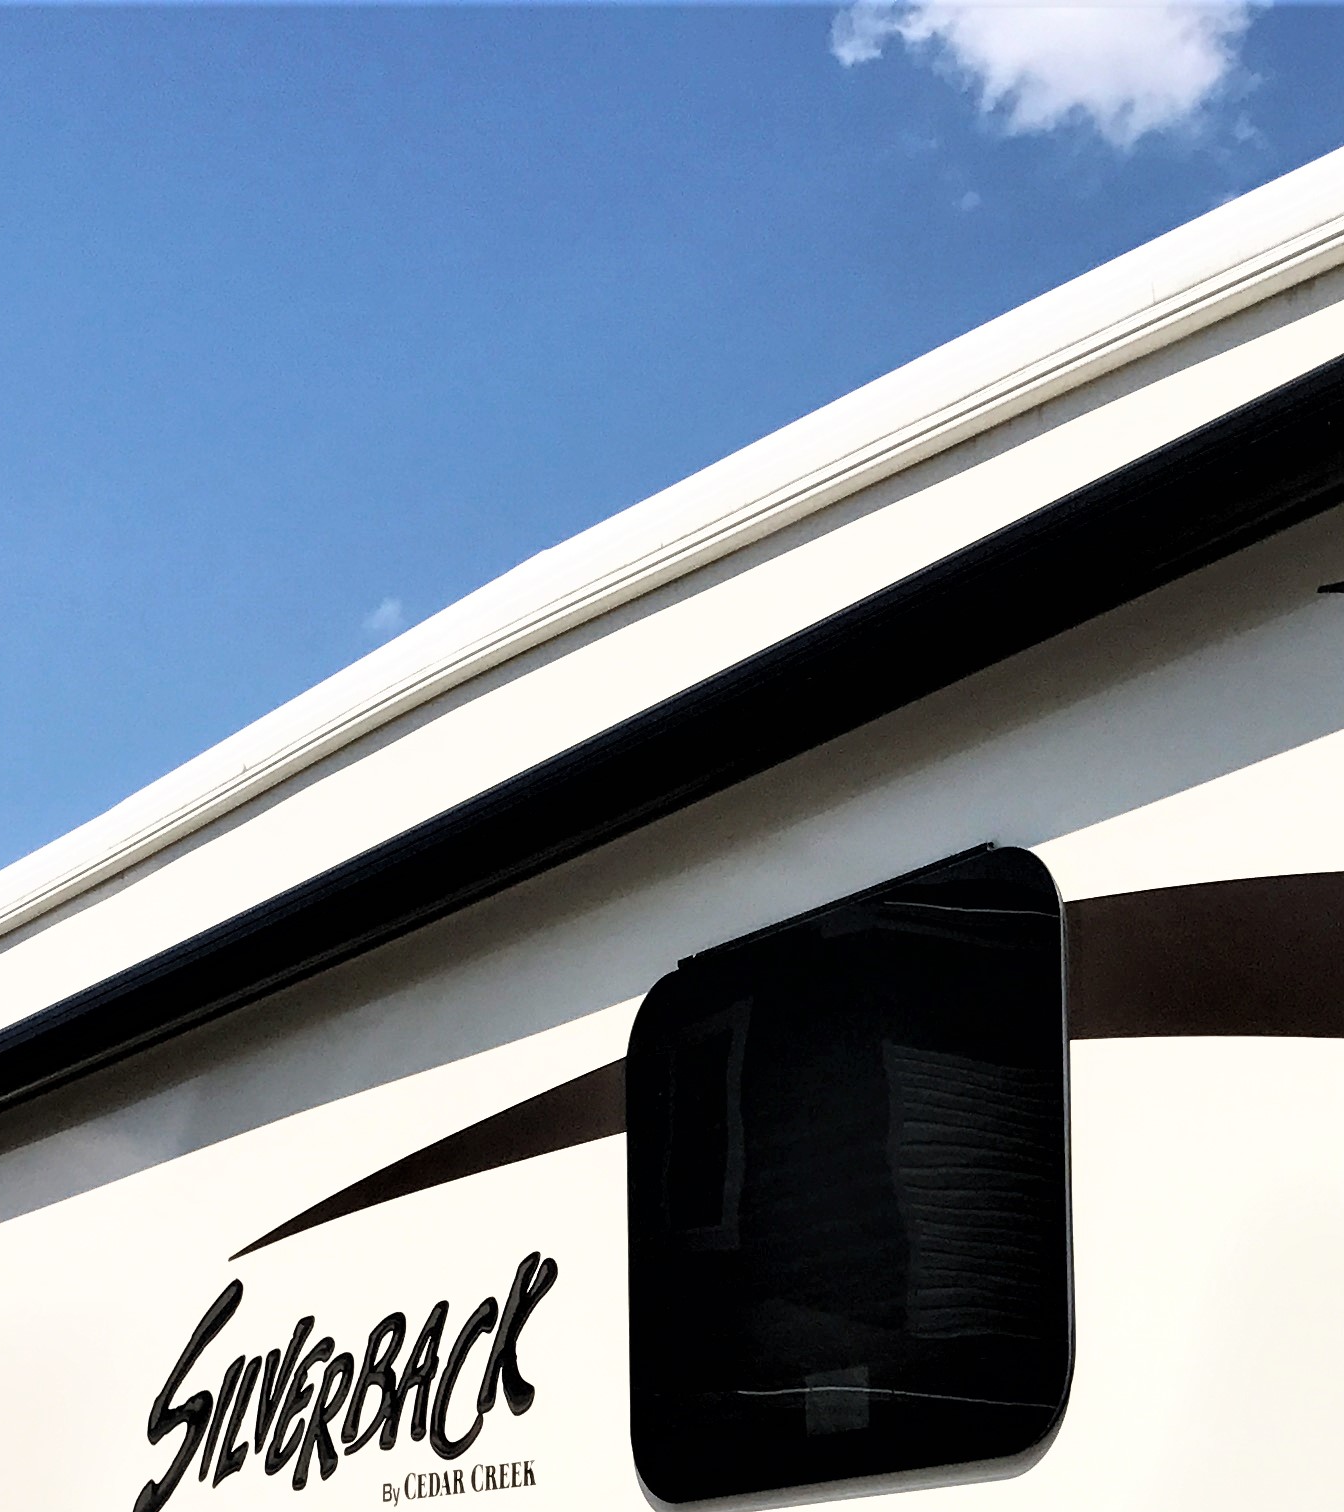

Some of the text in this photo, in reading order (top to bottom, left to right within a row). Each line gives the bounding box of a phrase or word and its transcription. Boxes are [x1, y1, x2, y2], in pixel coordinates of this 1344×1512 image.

[382, 1459, 537, 1508] By CEDAR CREEK
